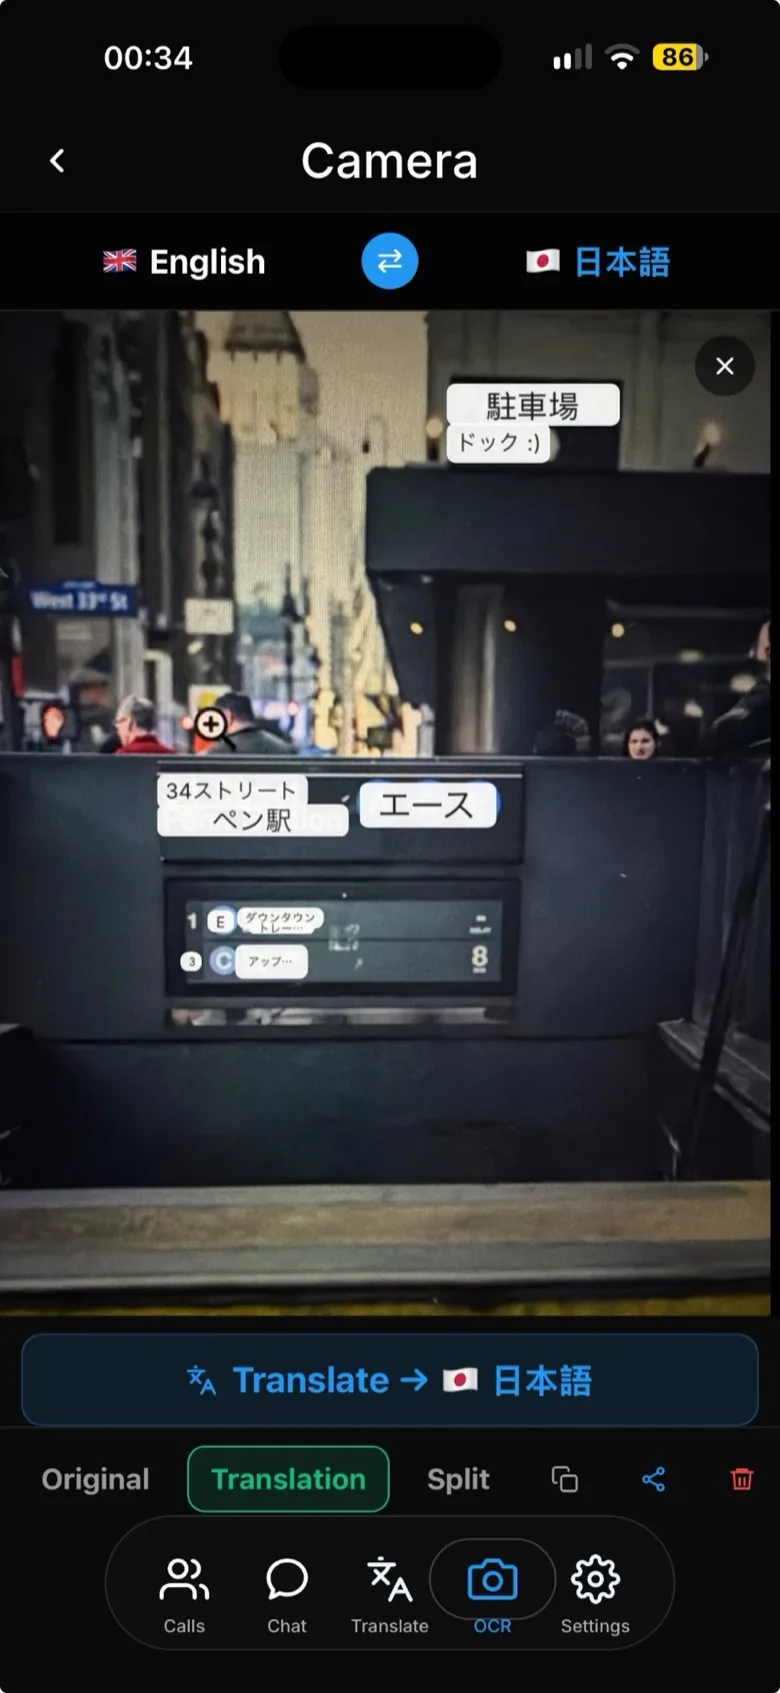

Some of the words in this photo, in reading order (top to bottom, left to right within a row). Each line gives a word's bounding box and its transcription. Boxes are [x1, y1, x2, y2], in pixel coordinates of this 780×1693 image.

[104, 46, 193, 71] 00:34
[662, 47, 693, 67] 86
[302, 141, 477, 180] Camera
[151, 247, 265, 280] English
[576, 245, 671, 279] 日本語
[187, 912, 197, 930] 1
[215, 952, 233, 969] C
[471, 945, 488, 967] 8
[232, 1365, 390, 1395] Translate
[495, 1364, 592, 1397] 日本語
[41, 1466, 149, 1496] Original
[211, 1466, 366, 1491] Translation
[427, 1466, 490, 1496] Split
[163, 1618, 206, 1634] Calls
[267, 1618, 307, 1634] Chat
[351, 1618, 429, 1634] Translate
[473, 1618, 512, 1634] OCR
[561, 1618, 630, 1637] Settings
